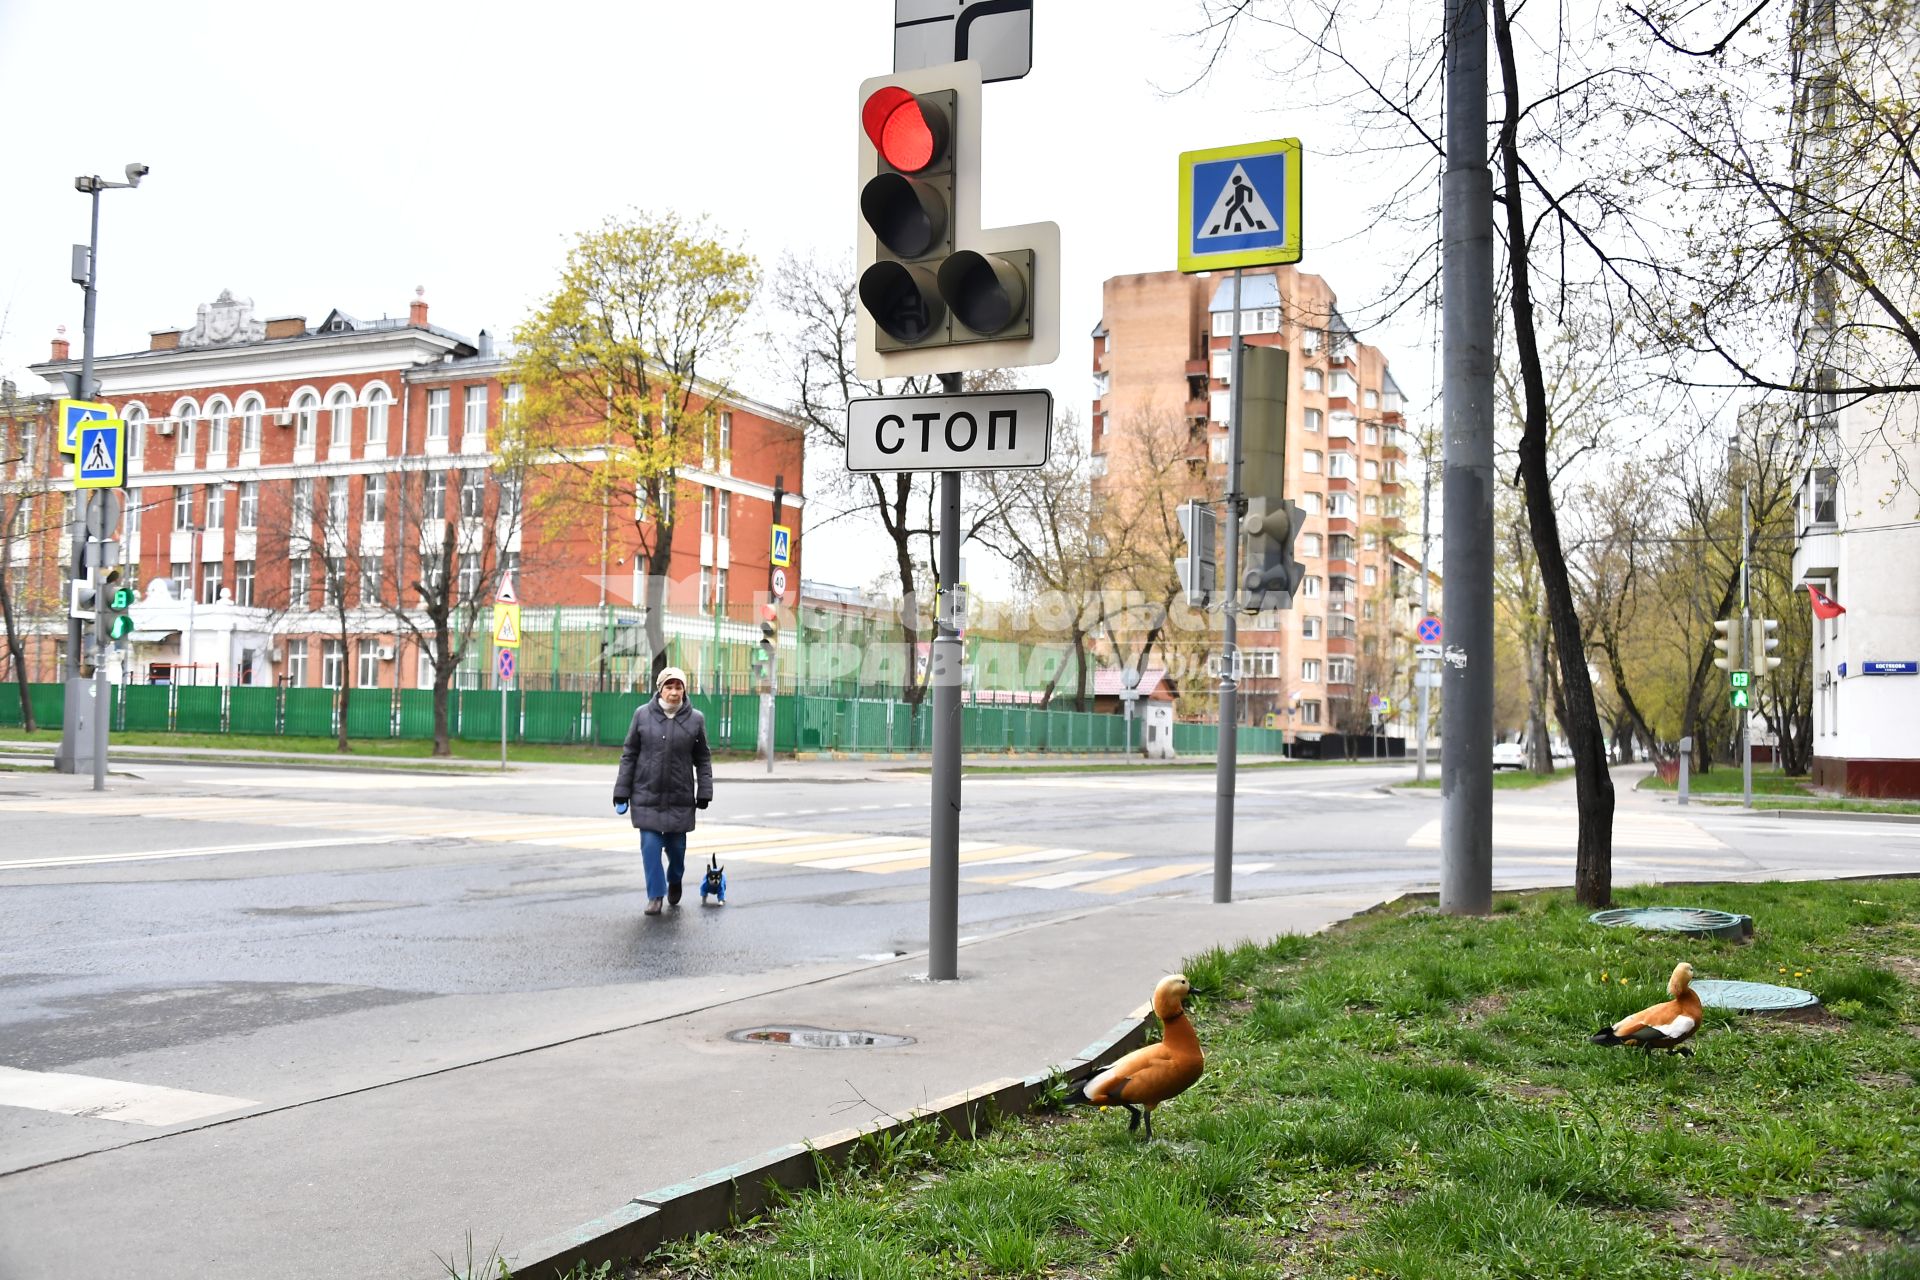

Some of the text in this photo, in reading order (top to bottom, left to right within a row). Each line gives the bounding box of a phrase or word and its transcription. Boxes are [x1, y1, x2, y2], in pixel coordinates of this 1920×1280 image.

[875, 410, 1017, 454] СТОП
[775, 576, 784, 589] 40
[1732, 673, 1748, 686] 03
